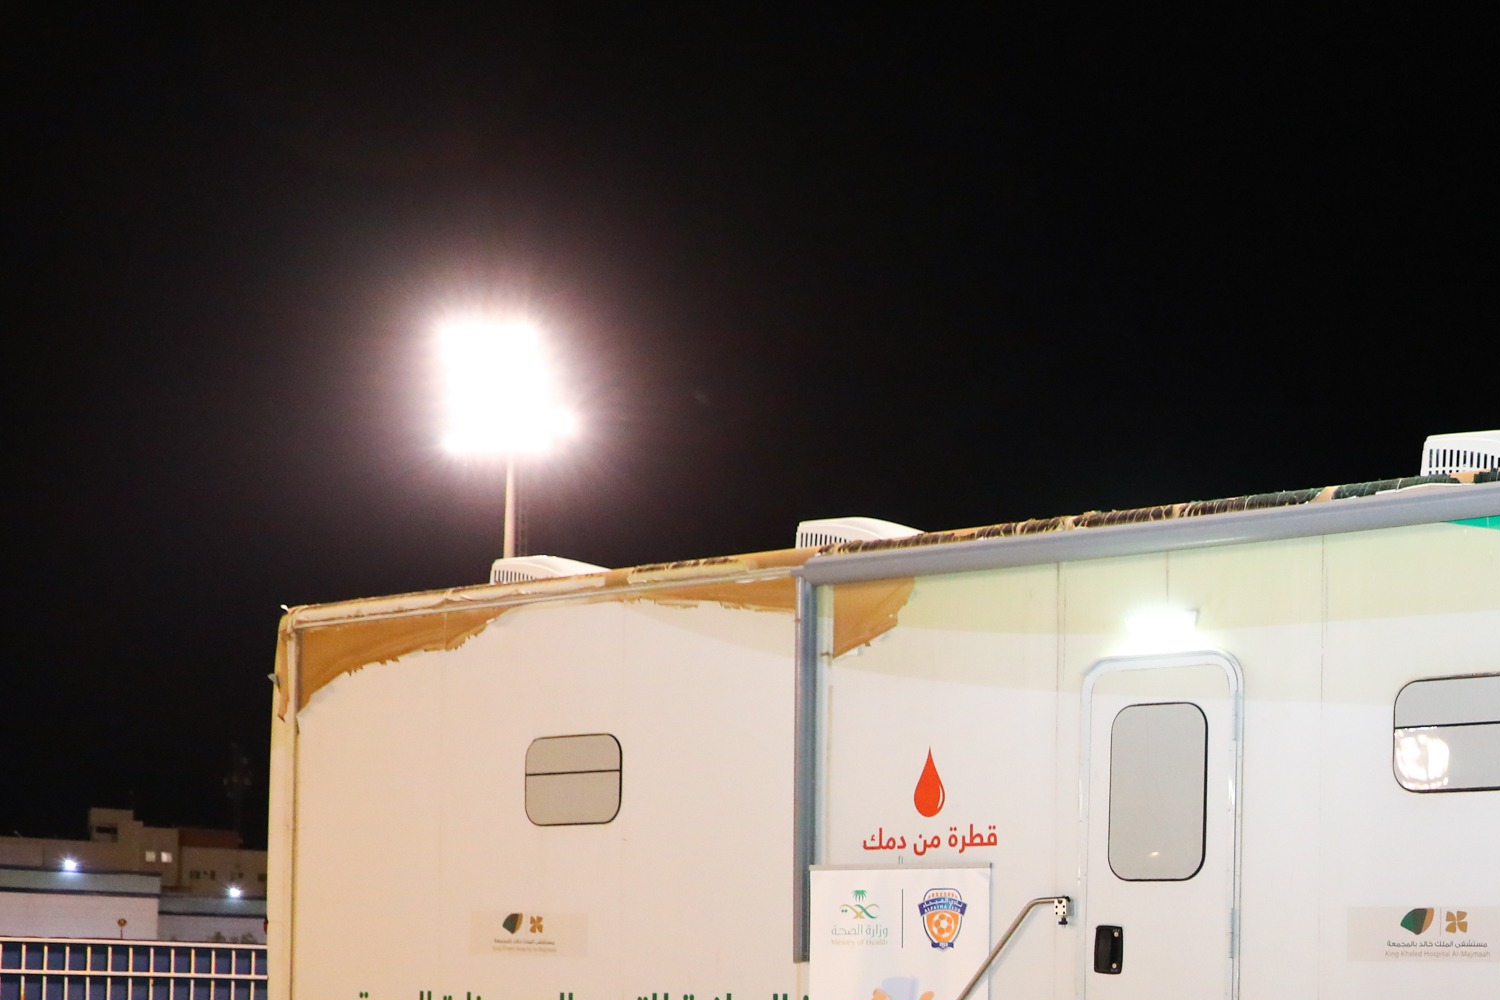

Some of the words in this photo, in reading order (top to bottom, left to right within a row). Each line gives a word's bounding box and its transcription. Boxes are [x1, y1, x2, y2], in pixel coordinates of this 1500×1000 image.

[862, 827, 907, 852] دمك
[913, 830, 941, 856] من
[947, 823, 998, 854] قطرة
[831, 923, 863, 936] الصحة
[865, 923, 889, 938] وزارة
[1384, 950, 1400, 959] King
[1424, 950, 1450, 959] Hospital
